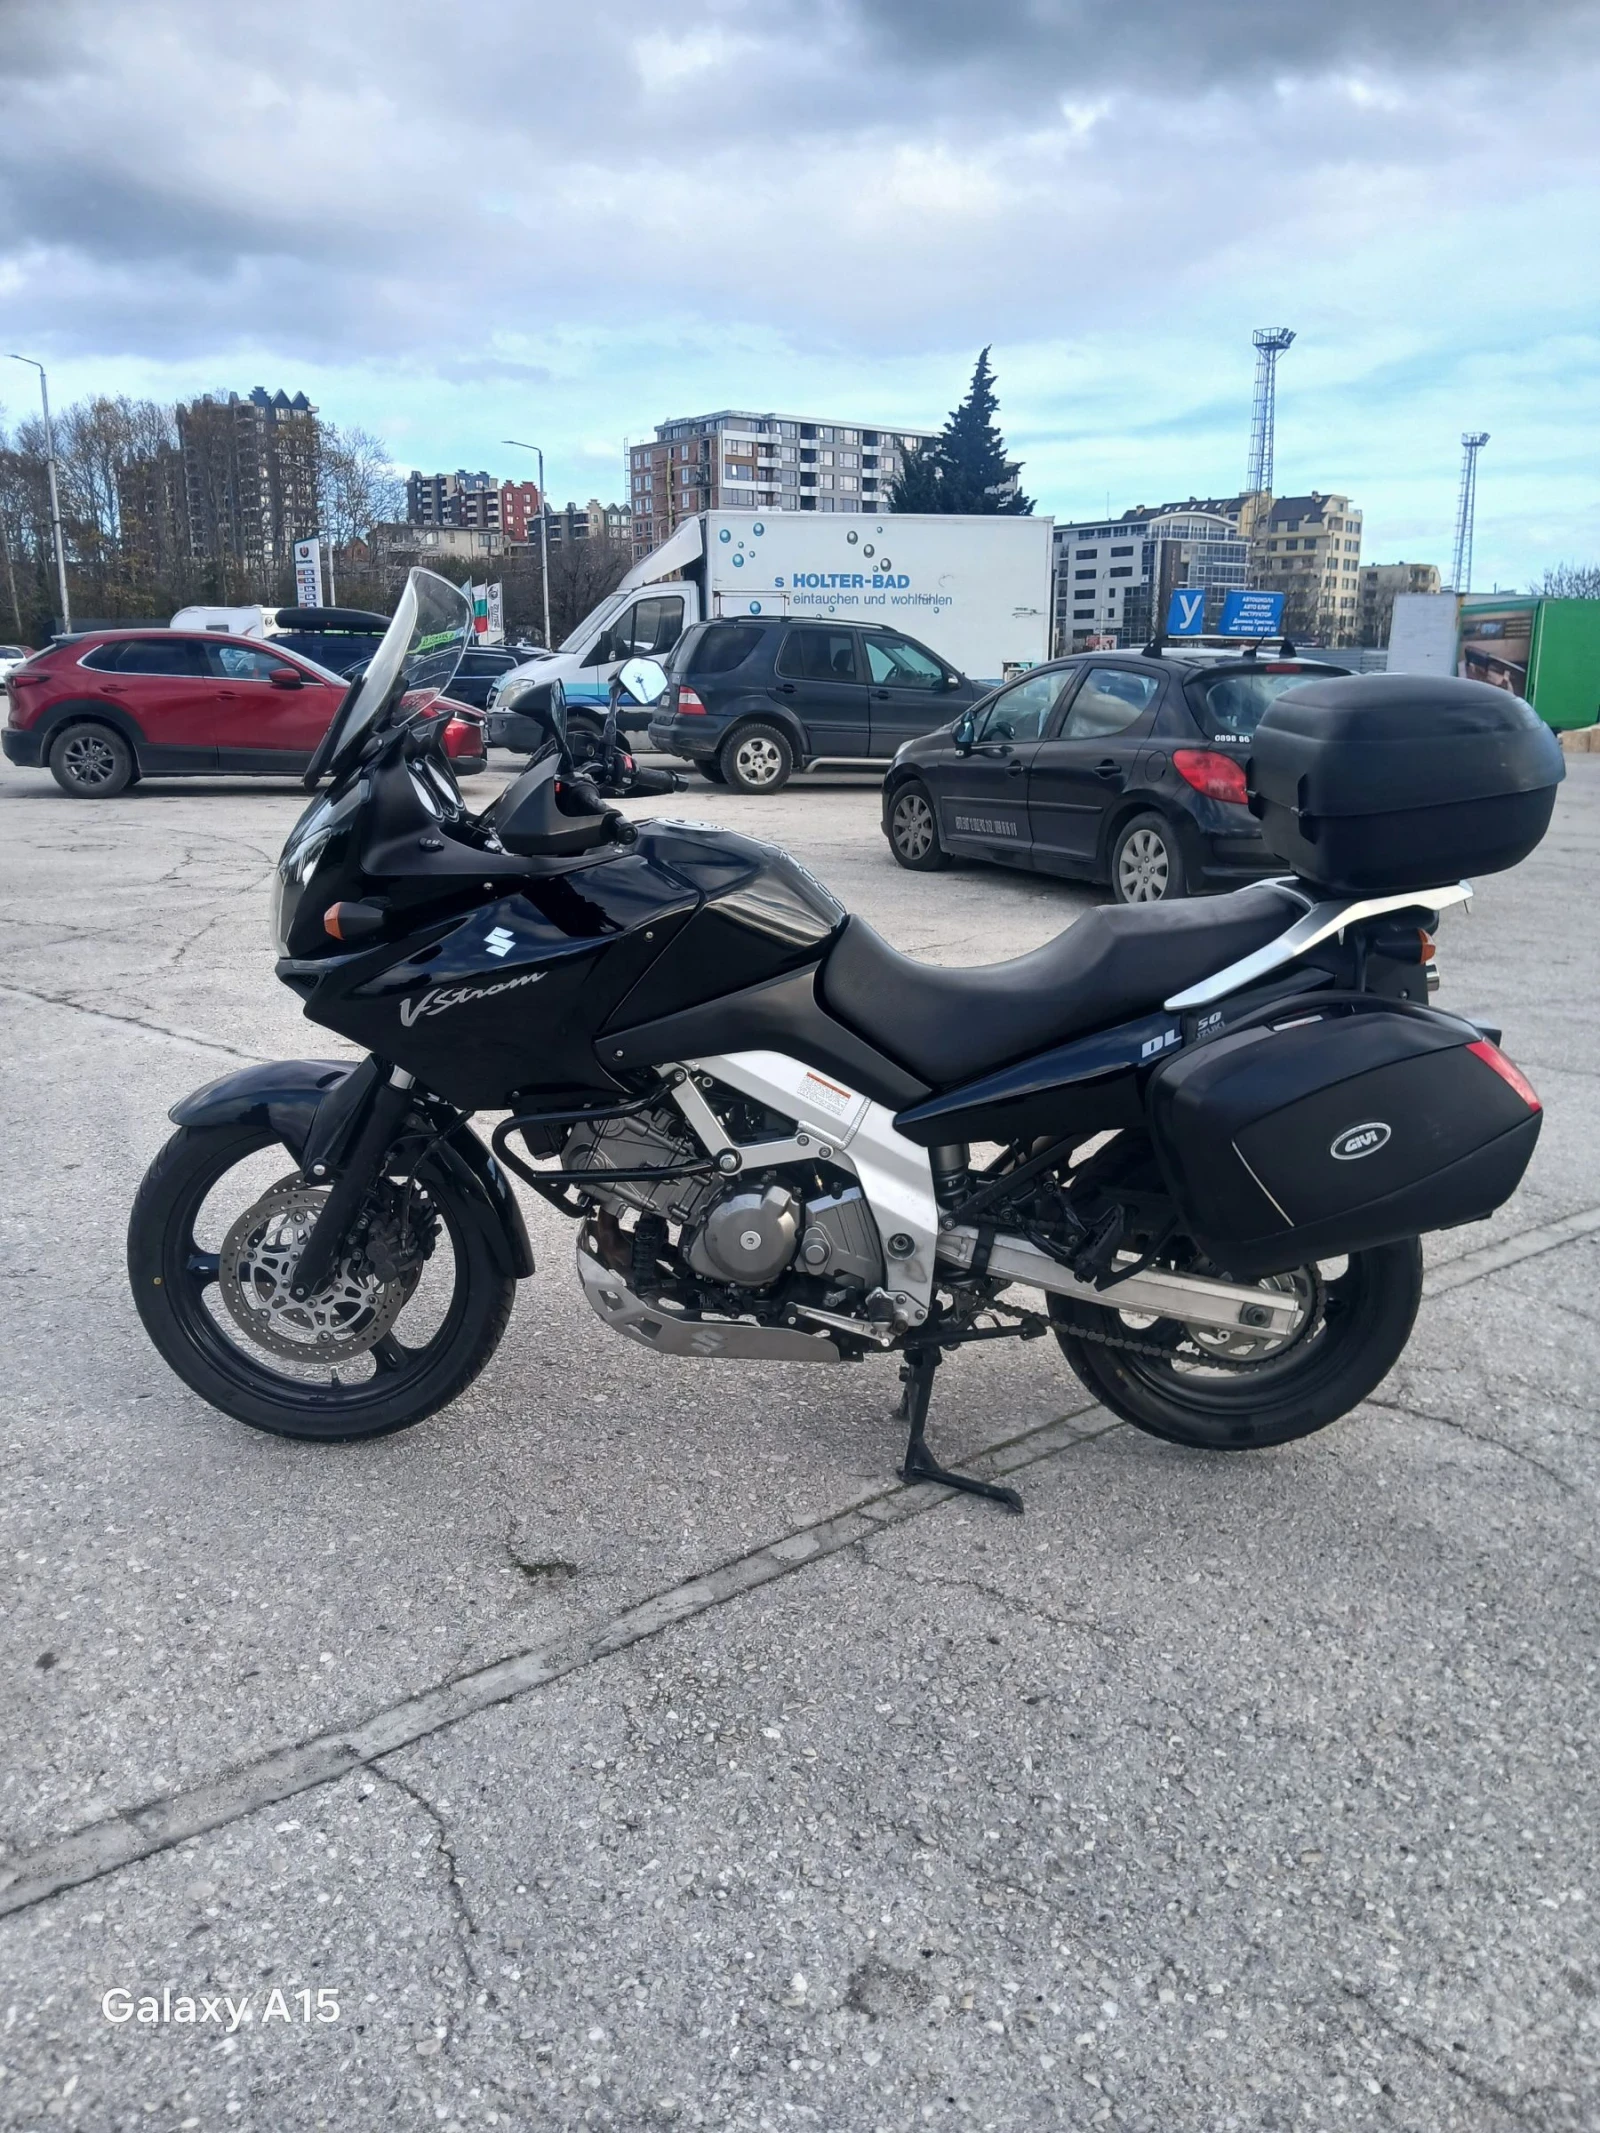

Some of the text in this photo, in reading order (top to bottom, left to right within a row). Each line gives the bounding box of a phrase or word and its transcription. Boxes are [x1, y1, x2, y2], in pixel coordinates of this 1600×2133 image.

[793, 573, 910, 589] HOLTER-BAD
[793, 592, 953, 606] eintauchen und wohlfühlen
[1141, 1029, 1182, 1059] DL
[1344, 1129, 1379, 1153] GIVI
